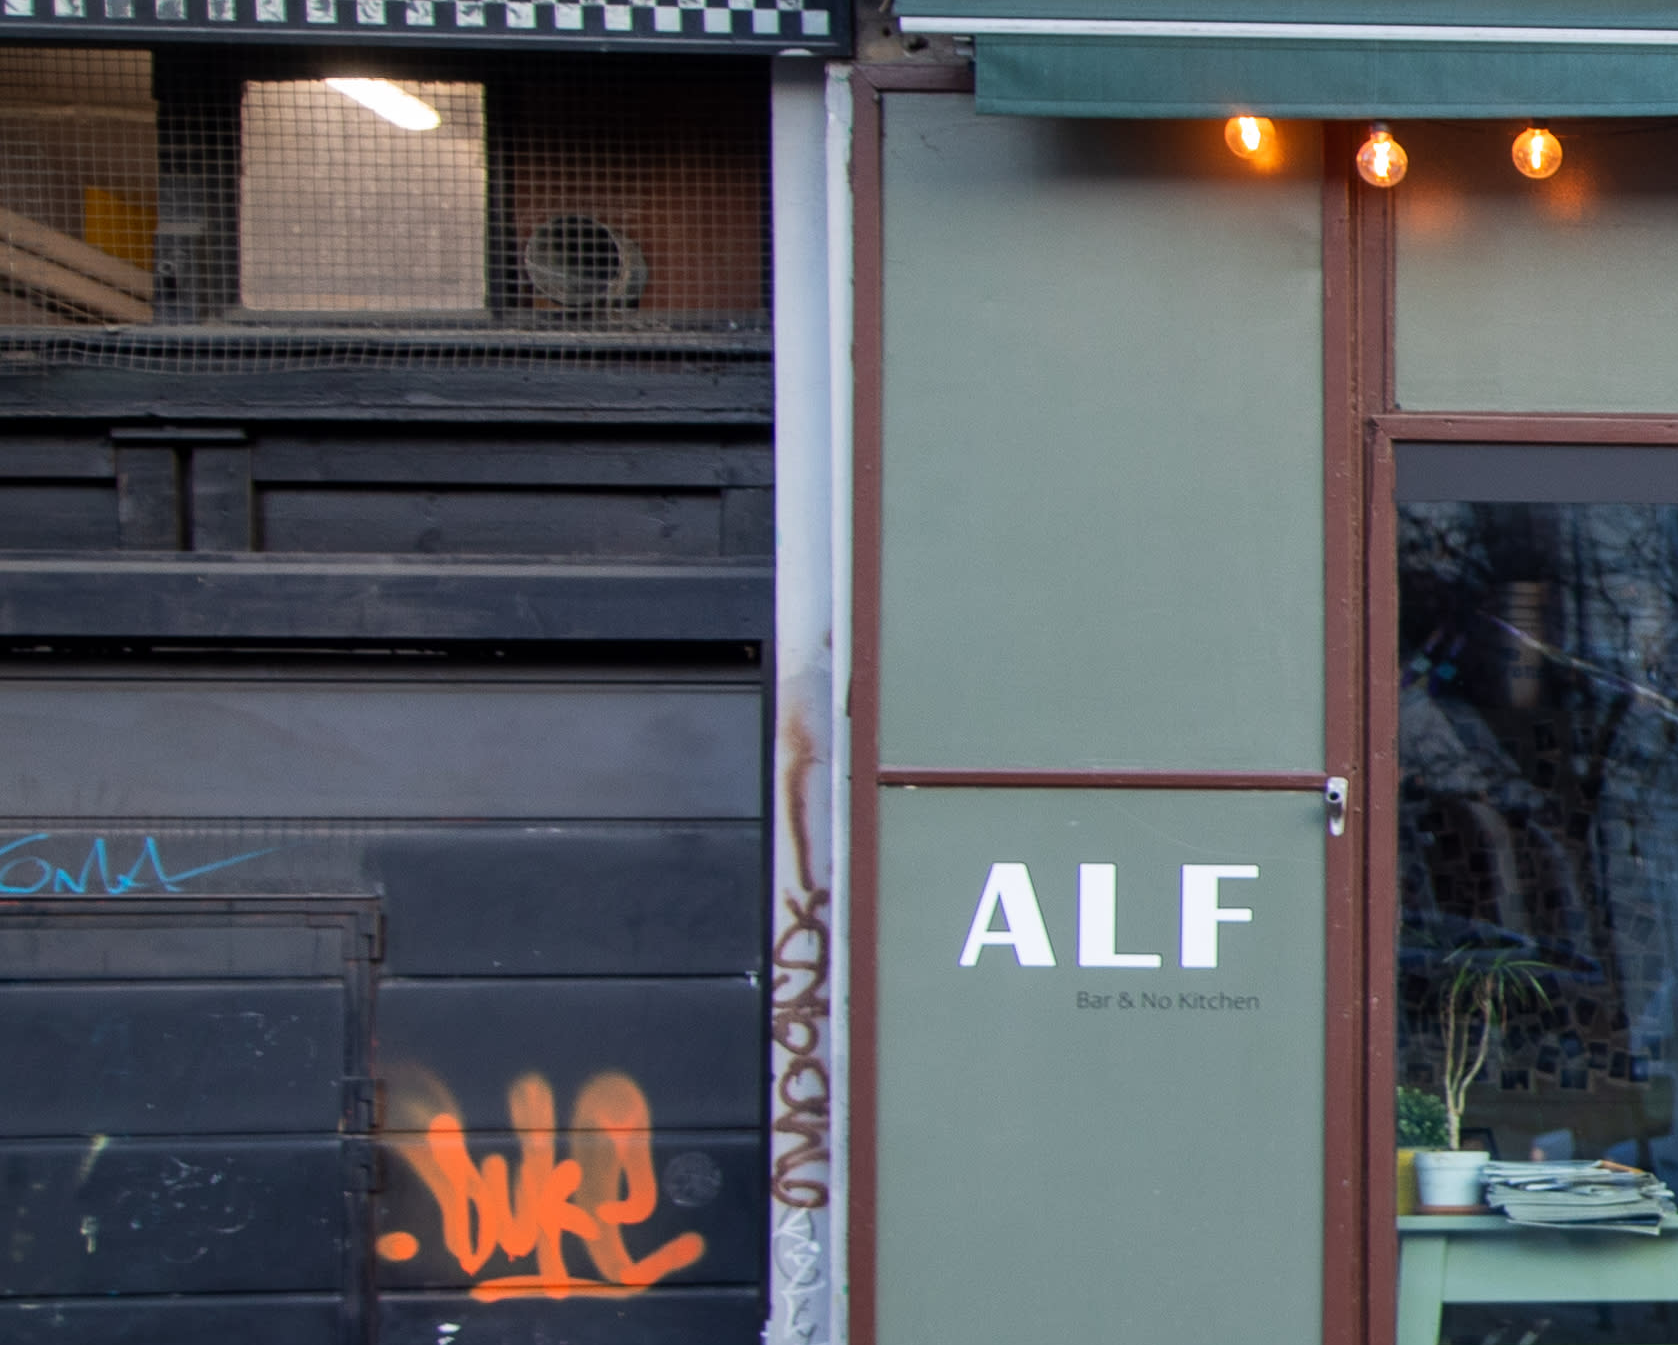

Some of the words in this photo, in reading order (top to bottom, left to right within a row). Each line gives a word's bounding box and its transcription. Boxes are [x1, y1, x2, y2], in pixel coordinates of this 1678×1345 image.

[958, 861, 1260, 969] ALF
[1076, 992, 1111, 1010] Bar
[1117, 991, 1135, 1010] &
[1141, 992, 1172, 1010] No
[1178, 991, 1260, 1010] Kitchen
